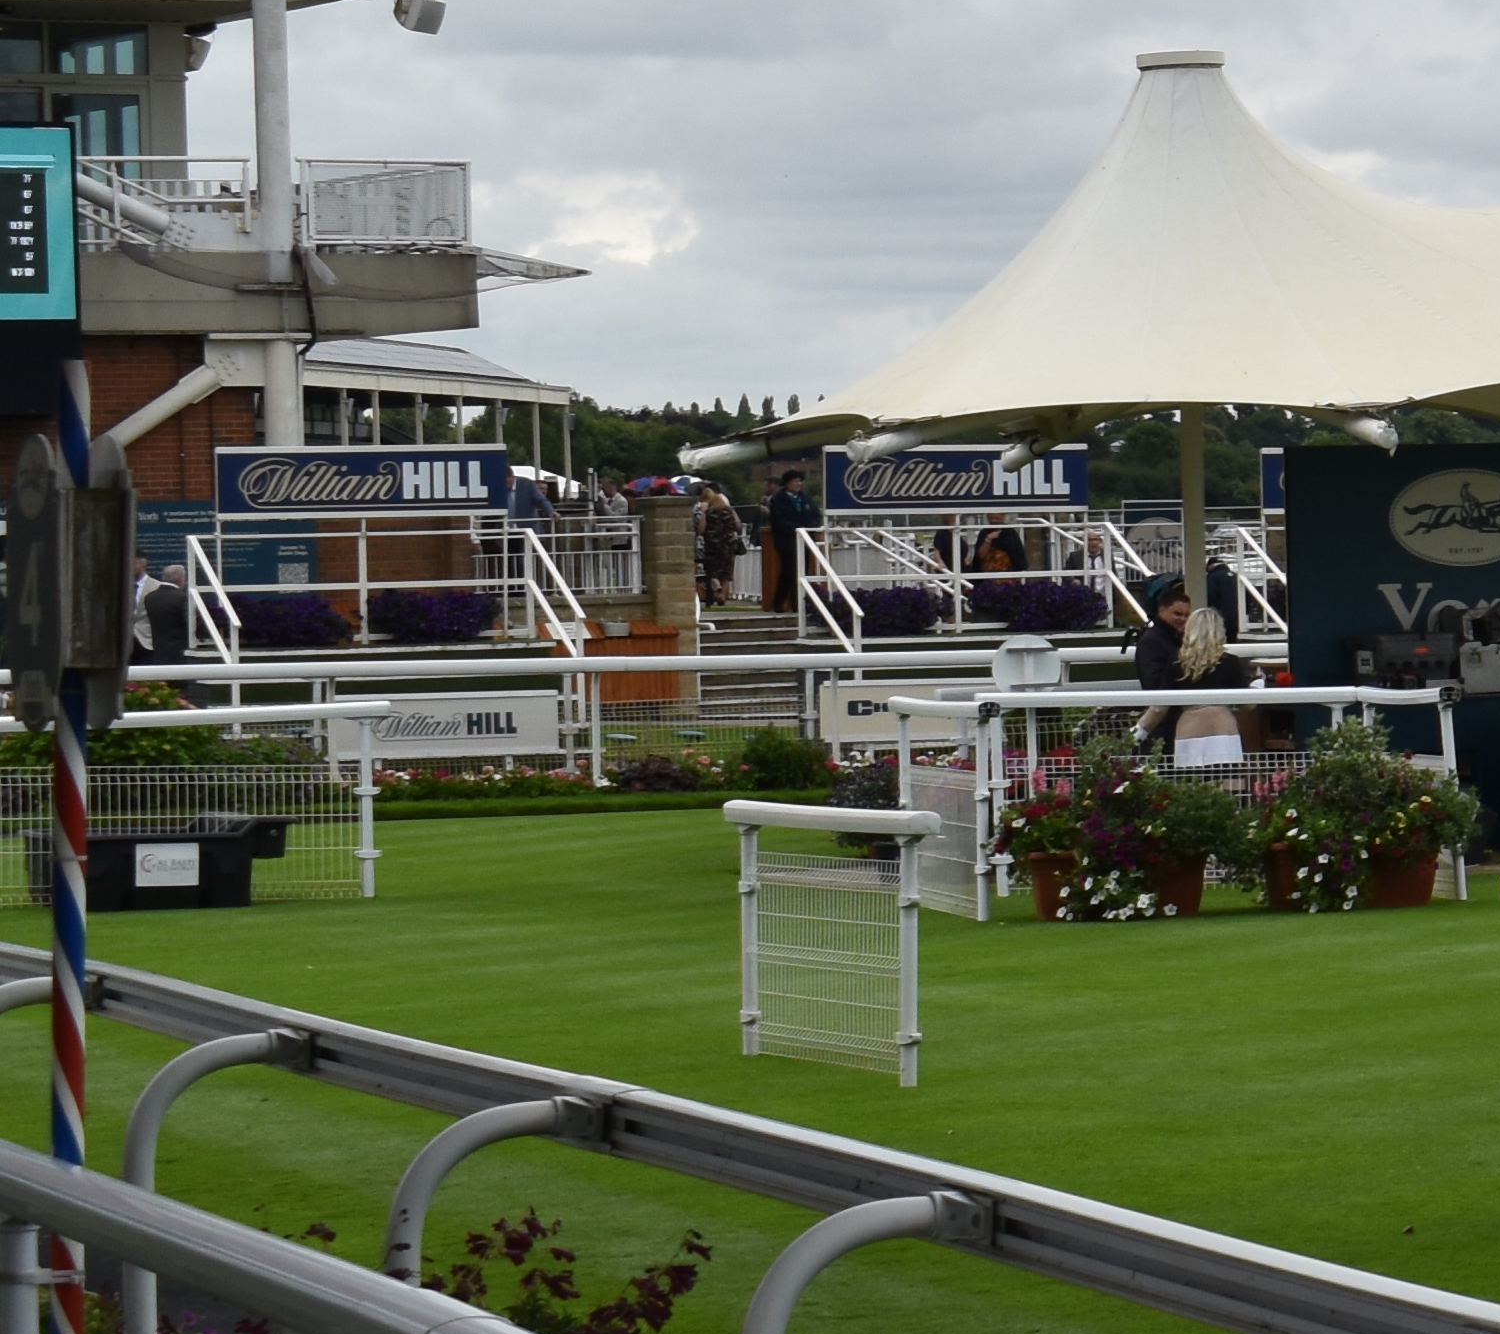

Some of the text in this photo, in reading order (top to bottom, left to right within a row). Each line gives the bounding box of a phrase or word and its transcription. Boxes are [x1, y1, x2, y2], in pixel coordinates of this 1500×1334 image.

[238, 457, 489, 505] William HILL
[844, 456, 1070, 500] William HILL
[371, 711, 518, 739] William HILL
